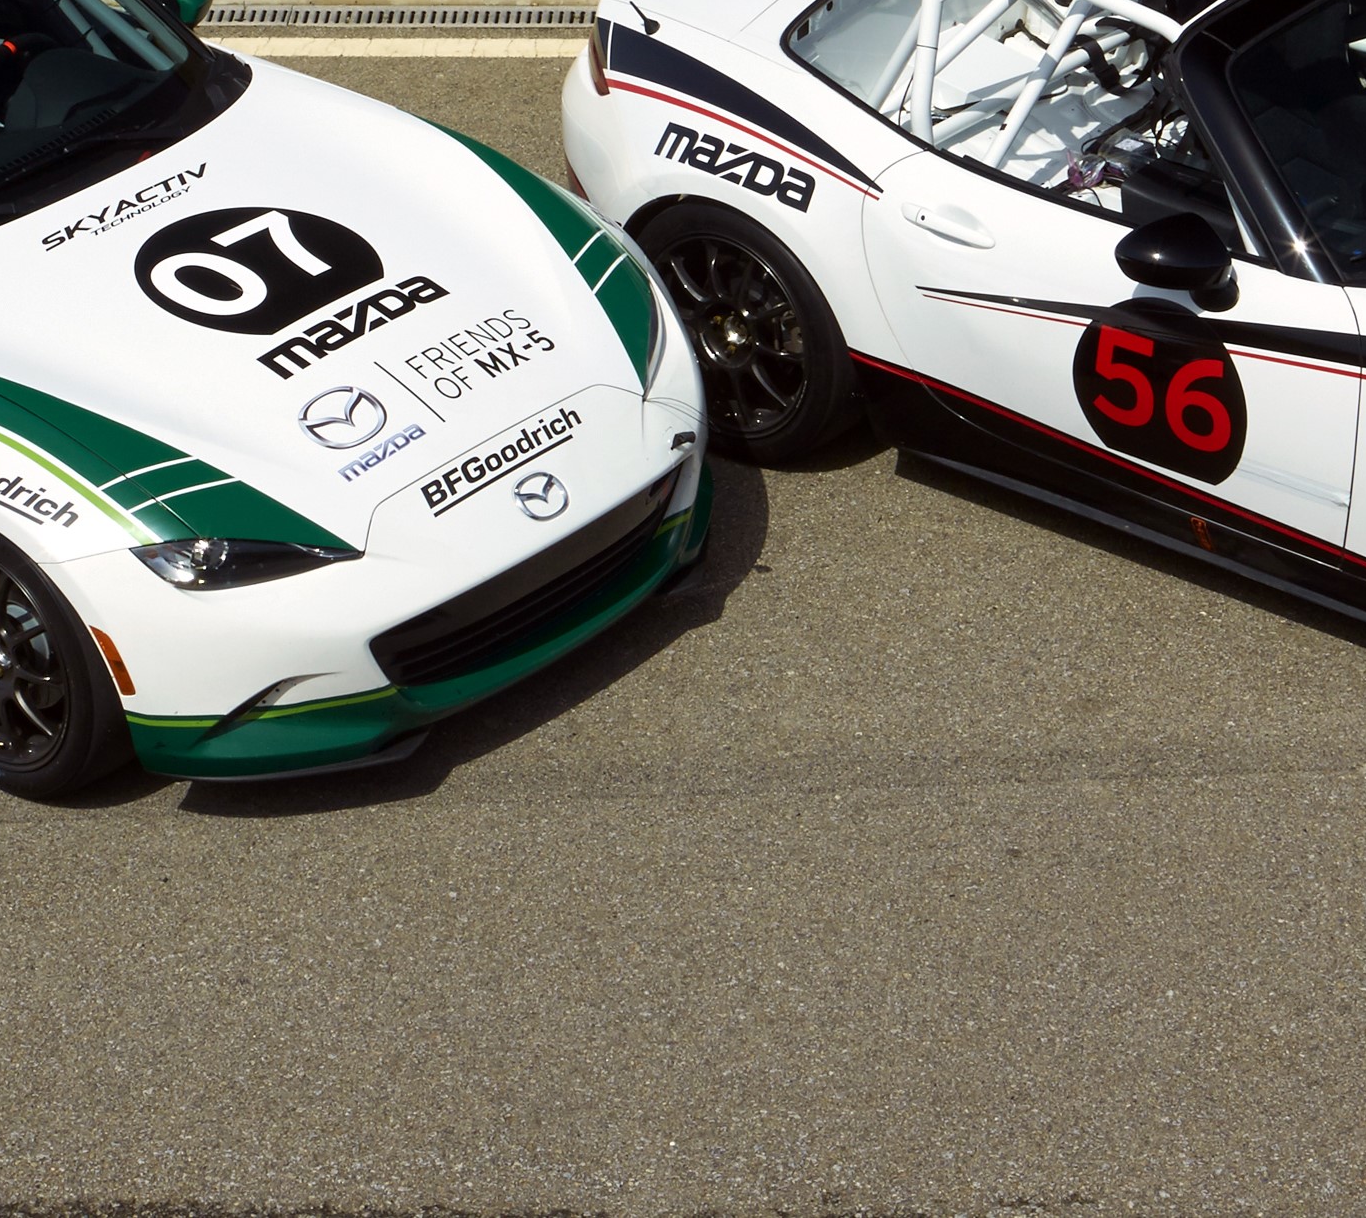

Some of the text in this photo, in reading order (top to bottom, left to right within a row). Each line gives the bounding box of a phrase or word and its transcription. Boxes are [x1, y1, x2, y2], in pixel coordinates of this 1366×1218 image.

[41, 162, 208, 251] SKYACTIV
[90, 185, 191, 236] TECHNOLOGY
[150, 210, 332, 316] 07
[405, 308, 532, 379] FRIENDS
[434, 330, 555, 400] OF MX-5
[1093, 324, 1232, 452] 56
[420, 407, 582, 507] BFGoodrich
